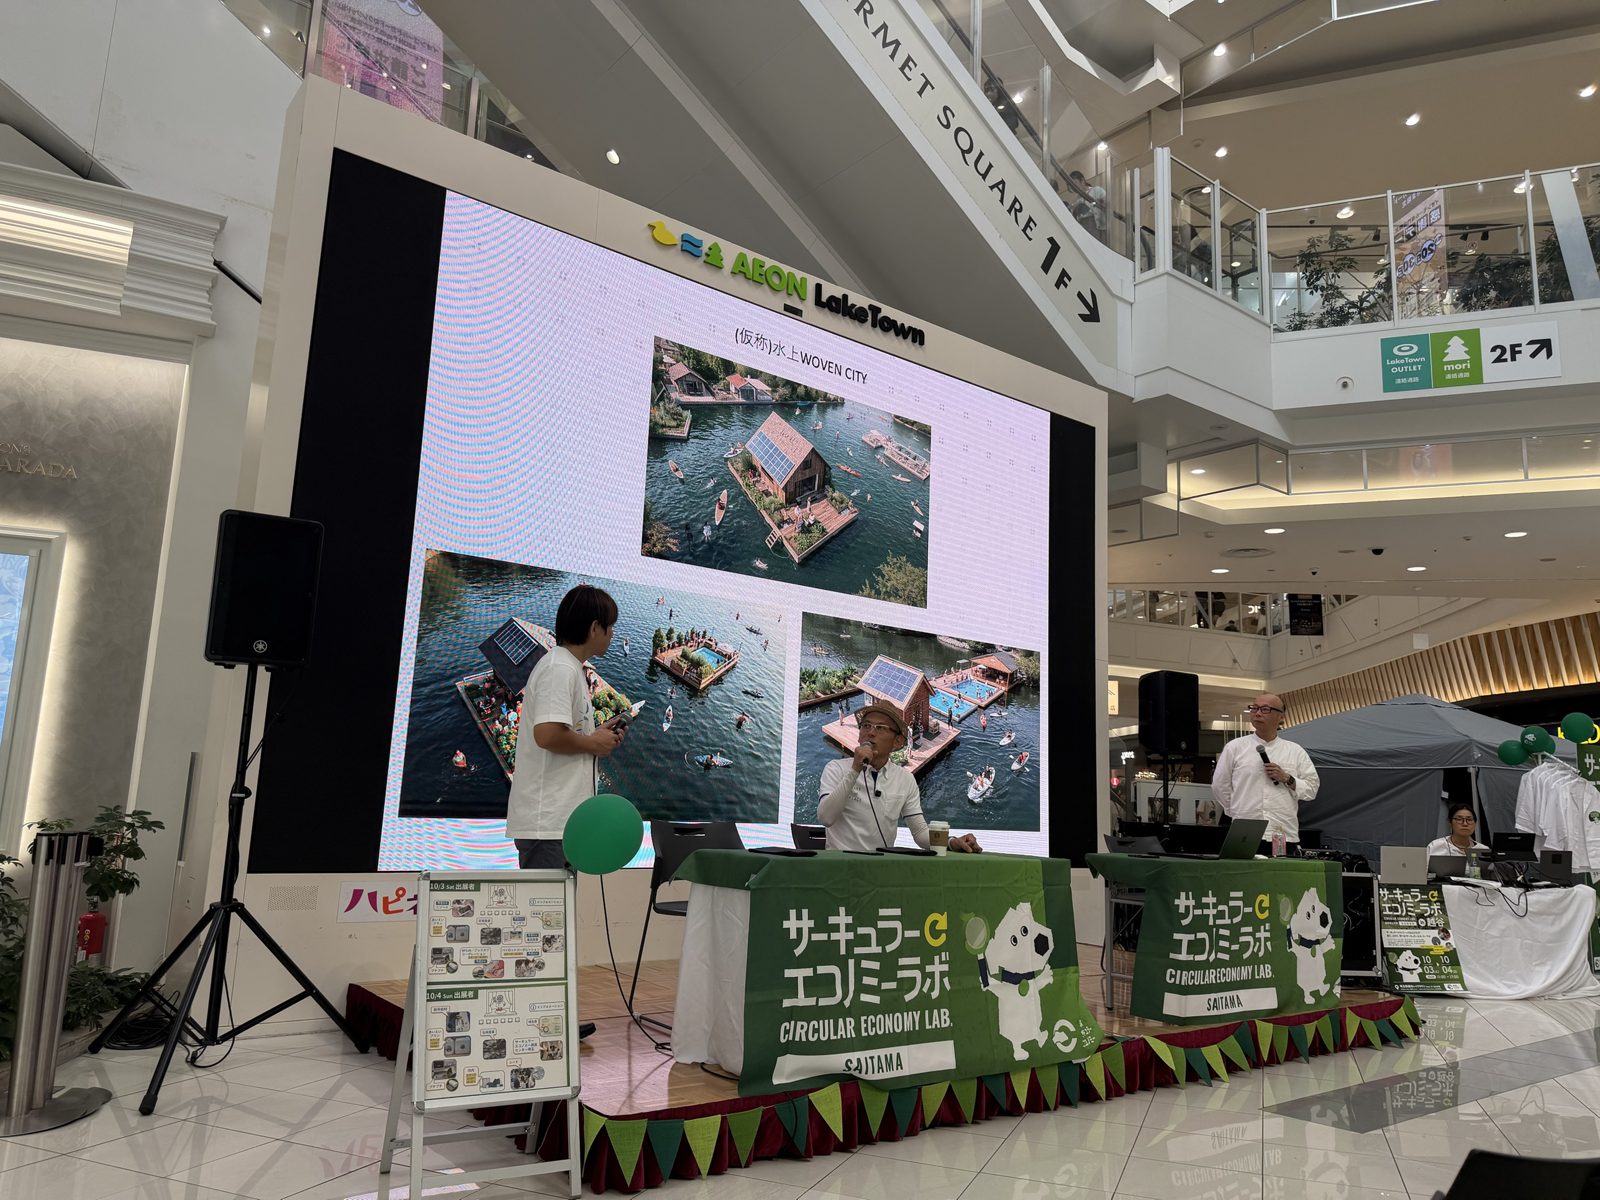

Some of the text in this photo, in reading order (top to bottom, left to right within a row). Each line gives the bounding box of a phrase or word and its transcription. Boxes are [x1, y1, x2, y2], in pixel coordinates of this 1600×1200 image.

[937, 105, 1038, 242] SQUARE
[731, 252, 925, 346] AEON LakeTown
[1387, 356, 1426, 365] LakeTown
[1490, 343, 1523, 364] 2F
[1391, 365, 1422, 373] OUTLET
[1443, 360, 1471, 371] mori
[845, 366, 868, 384] CITY
[430, 882, 445, 891] 10/3
[1381, 902, 1442, 916] エコノミーラボ
[1169, 923, 1272, 962] エコノミーラボ
[1422, 956, 1432, 964] 10
[1440, 956, 1450, 964] 10
[1424, 966, 1435, 974] 03
[1442, 966, 1453, 974] 04
[782, 952, 951, 1008] エコノミーラボ
[426, 991, 441, 1000] 10/4
[1206, 994, 1243, 1012] SAITAMA
[779, 1008, 953, 1043] CIRCULAR ECONOMY LAB.
[843, 1052, 904, 1075] SAITAMA
